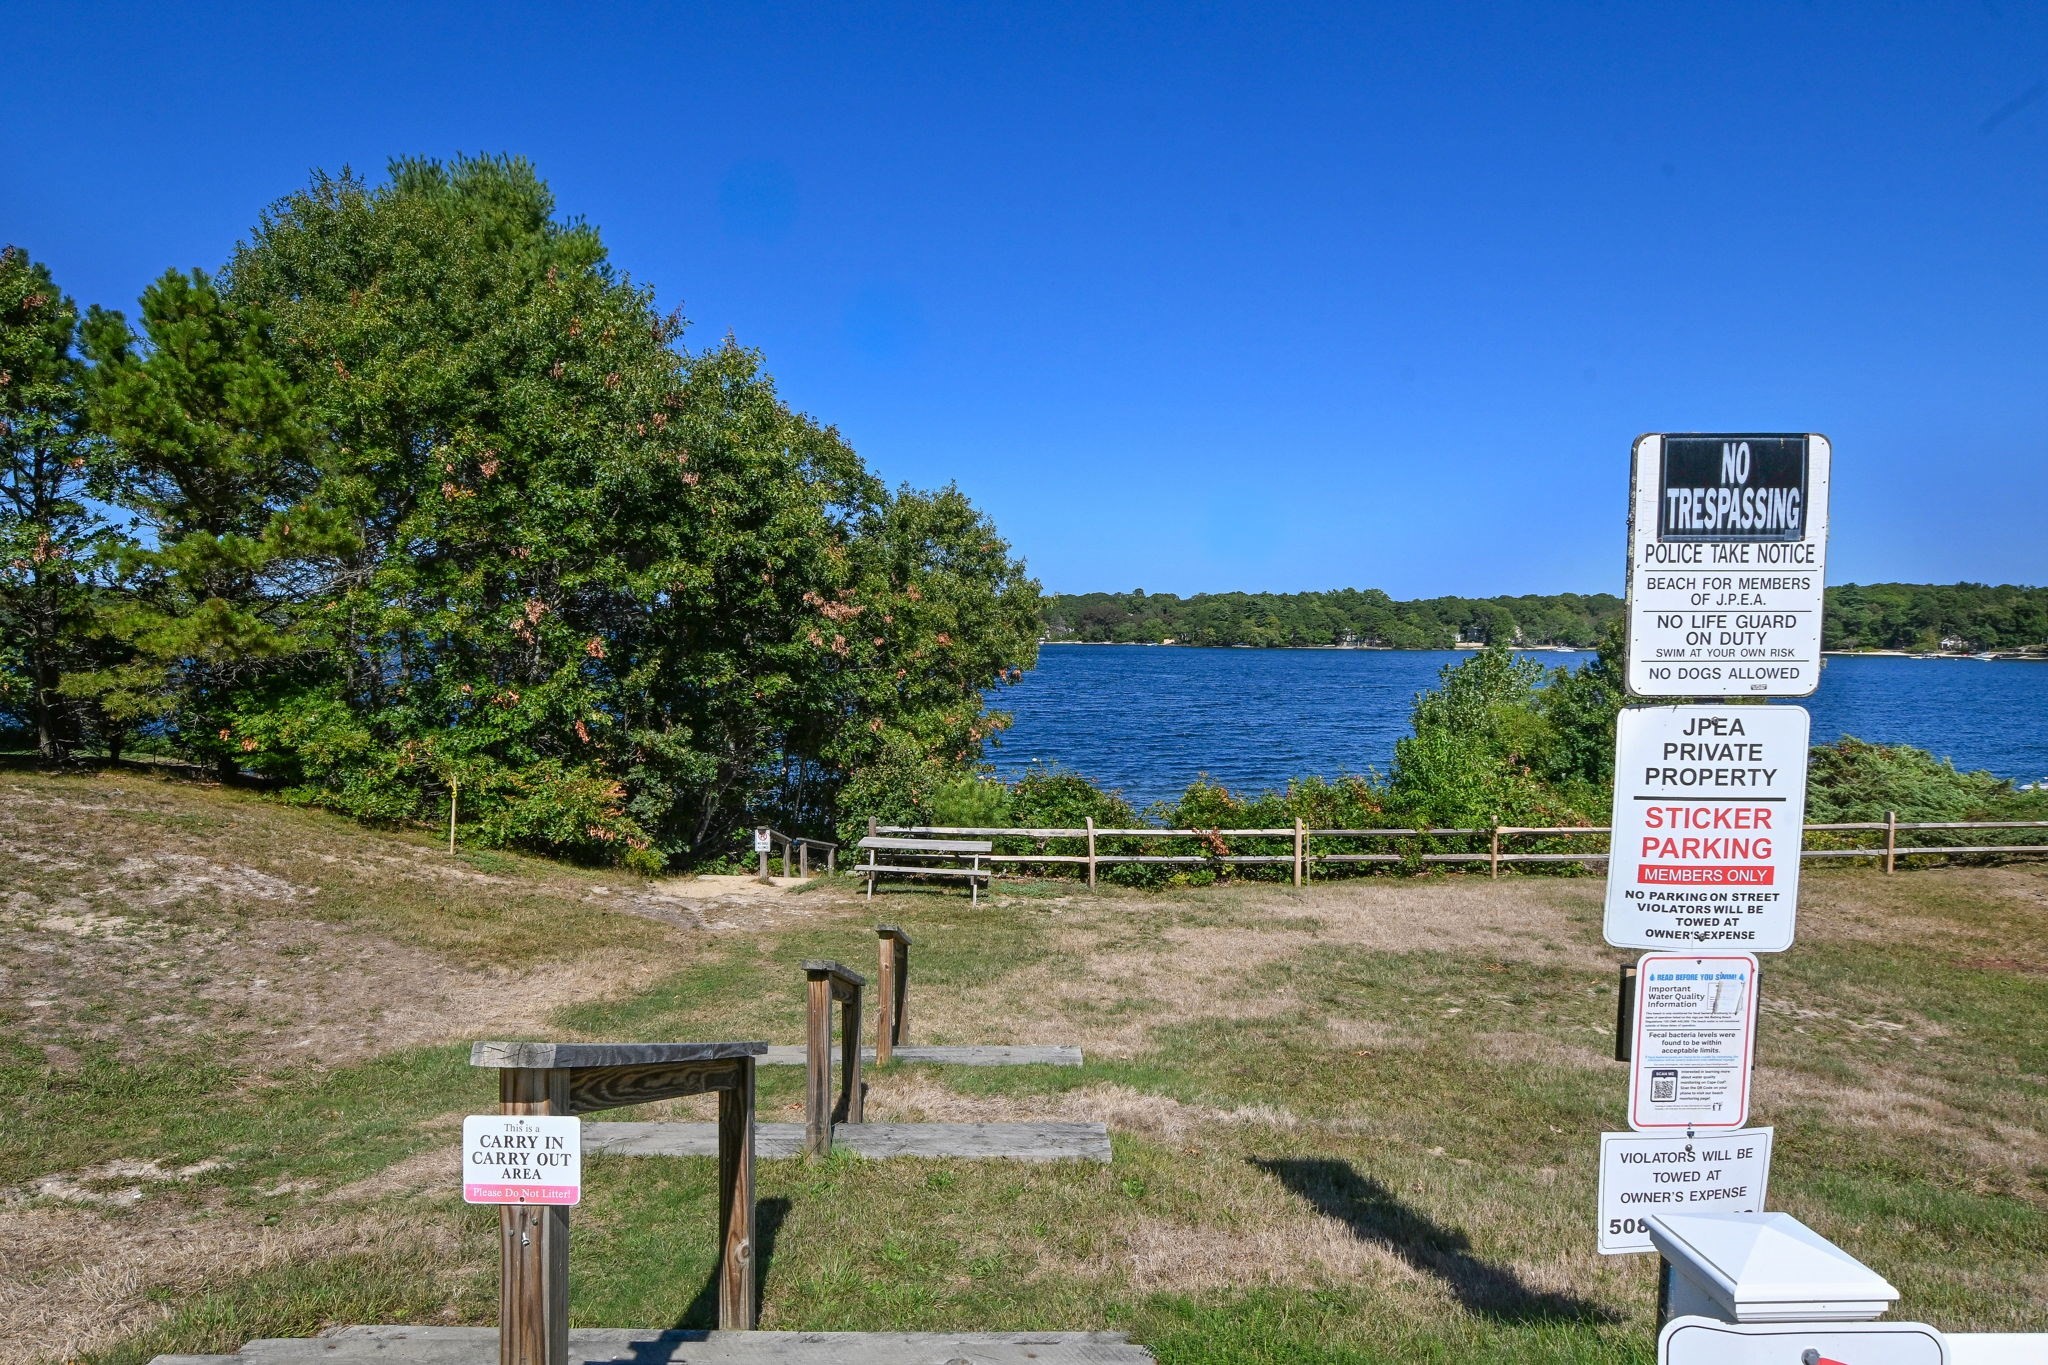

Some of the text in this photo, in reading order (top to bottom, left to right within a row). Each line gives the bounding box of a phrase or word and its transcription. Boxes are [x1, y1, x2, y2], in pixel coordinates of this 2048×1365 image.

[1721, 442, 1750, 484] NO
[1667, 487, 1800, 529] TRESPASSING
[1645, 544, 1815, 563] POLICE TAKE NOTICE
[1647, 578, 1810, 589] BEACH FOR MEMBERS
[1691, 594, 1766, 606] OF J.P.E.A.
[1658, 615, 1796, 628] NO LIFE GUARD
[1686, 632, 1767, 645] ON DUTY
[1656, 649, 1795, 657] SWIM AT YOUR OWN RISK
[1649, 668, 1799, 679] NO DOGS ALLOWED
[1683, 718, 1745, 736] JPEA
[1663, 743, 1762, 761] PRIVATE
[1645, 768, 1778, 786] PROPERTY
[1645, 807, 1772, 829] STICKER
[1642, 837, 1772, 859] PARKING
[1644, 869, 1767, 882] MEMBERS ONLY
[1625, 891, 1780, 902] NO PARKING ON STREET
[1638, 903, 1763, 914] VIOLATORS WILL BE
[1676, 918, 1739, 926] TOWED AT
[1645, 929, 1755, 940] OWNER'S EXPENSE
[1675, 993, 1705, 1001] Quality
[504, 1124, 522, 1132] This
[480, 1135, 564, 1149] CARRY IN
[472, 1152, 571, 1166] CARRY OUT
[1621, 1148, 1753, 1163] VIOLATORS WILL BE
[502, 1168, 542, 1179] AREA
[1653, 1170, 1721, 1183] TOWED AT
[473, 1188, 570, 1198] Please Do Not Litter!
[1621, 1186, 1747, 1204] OWNER'S EXPENSE
